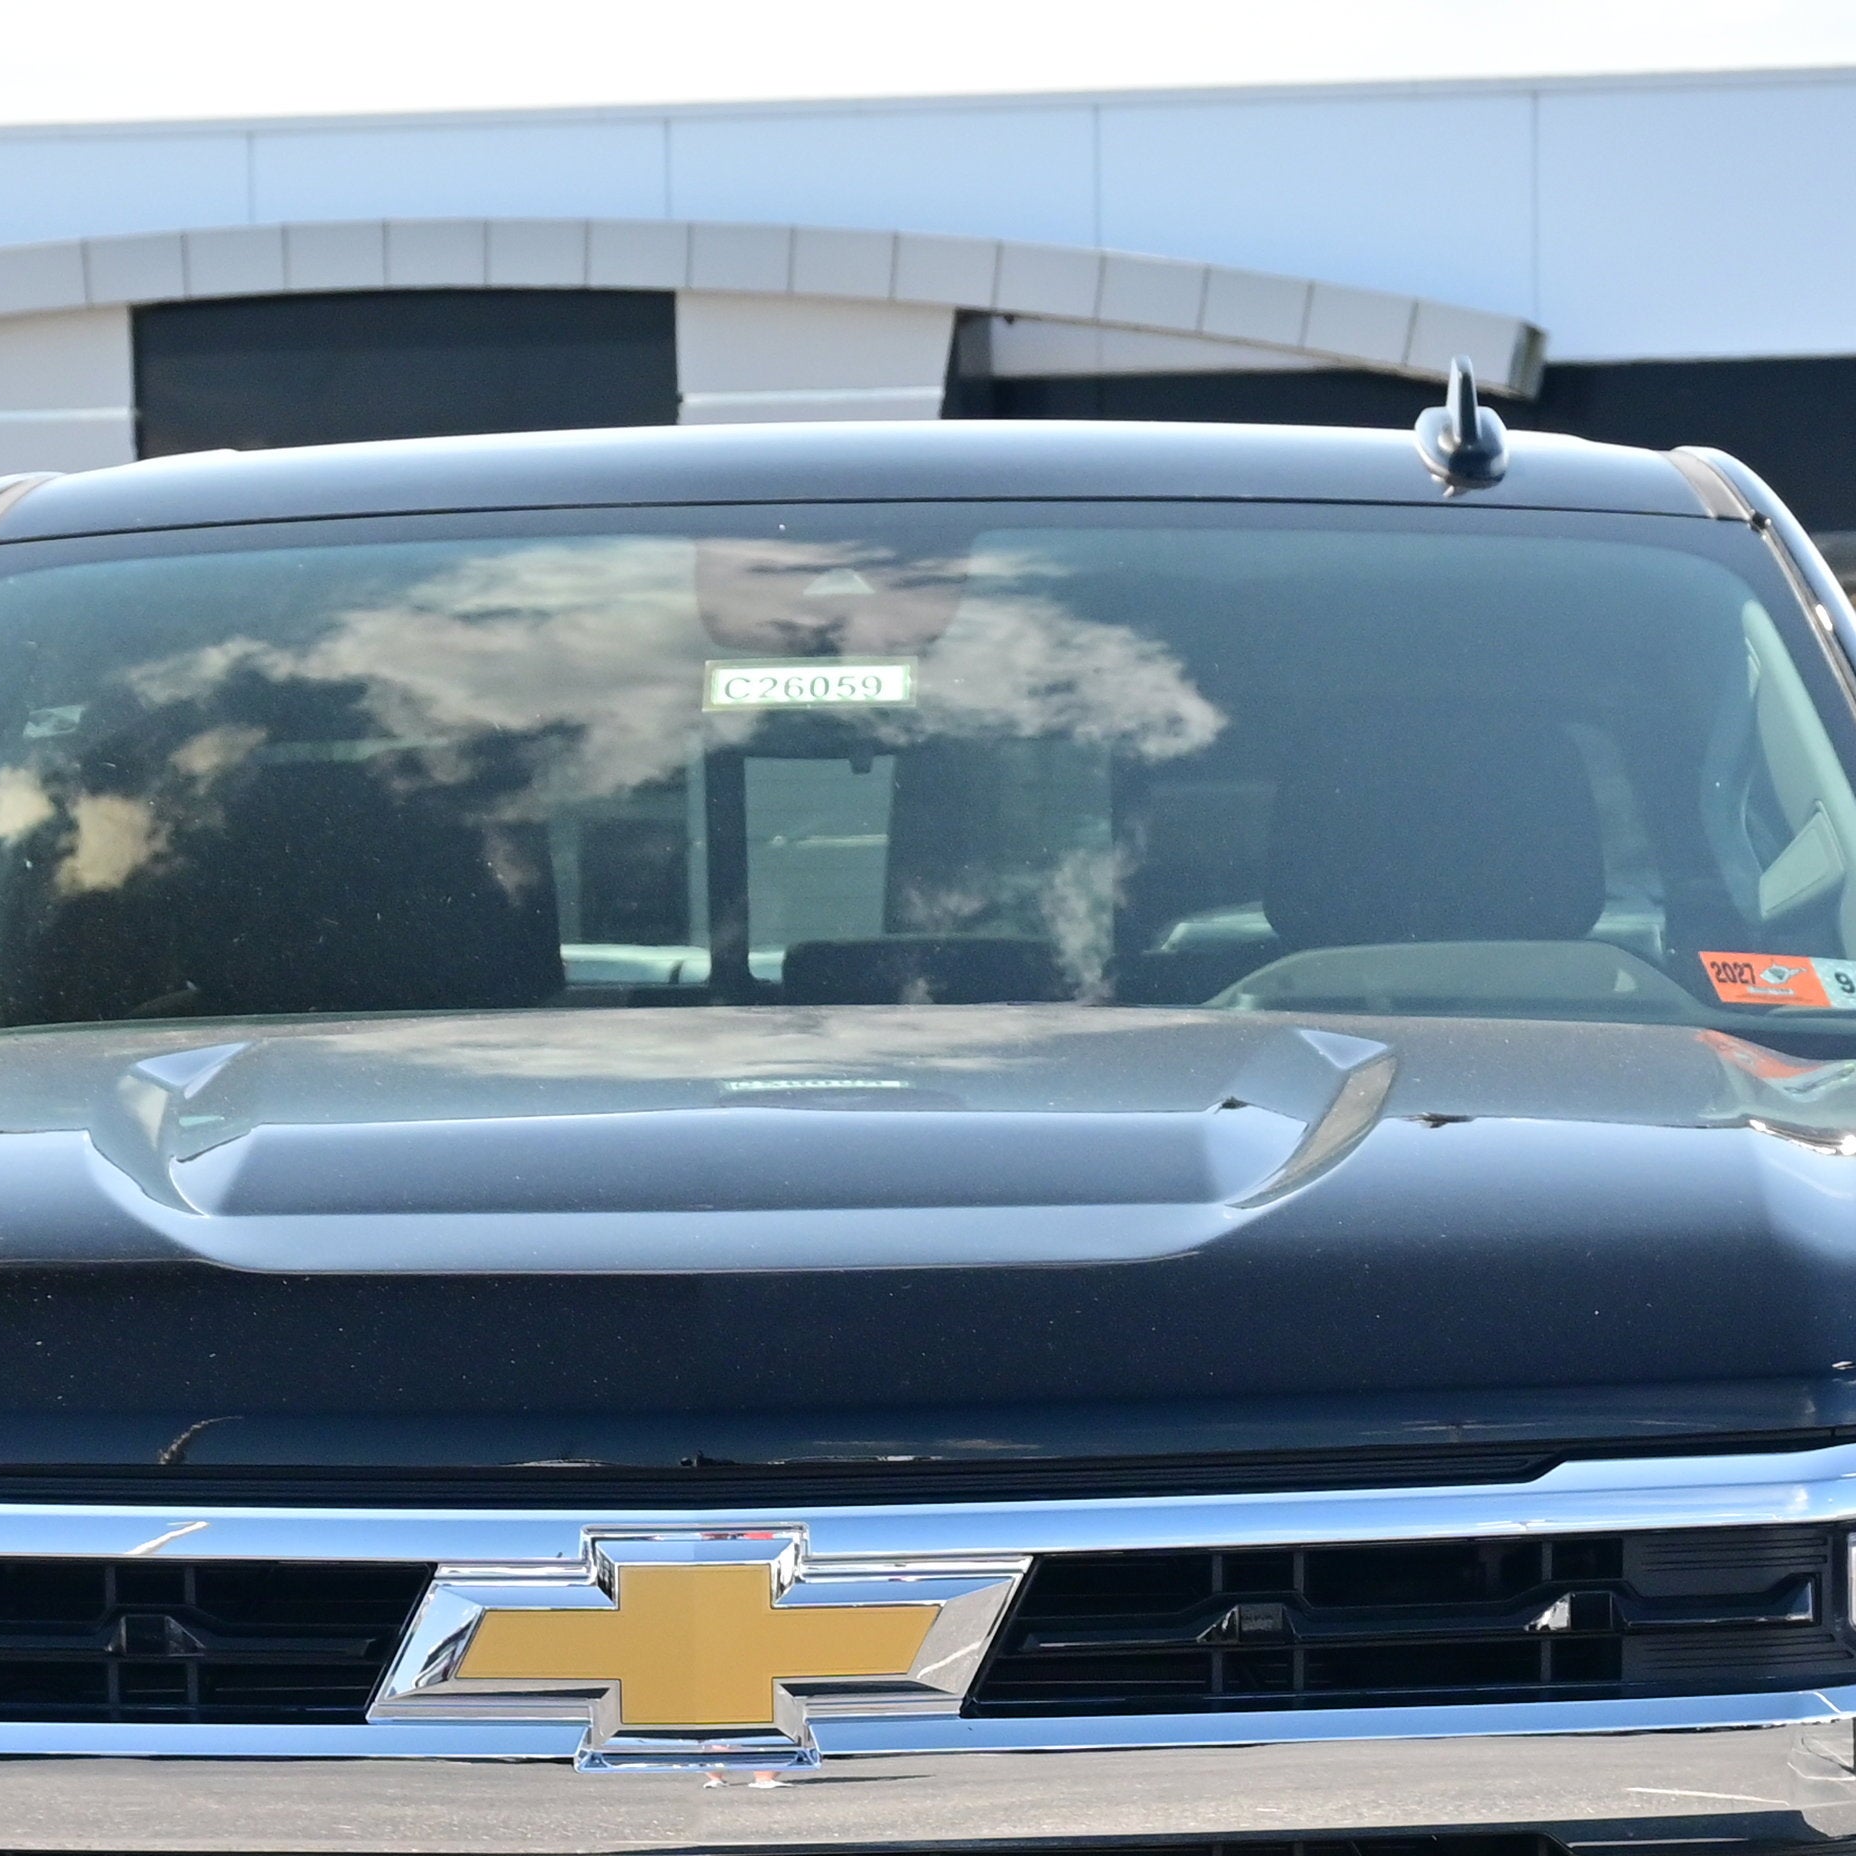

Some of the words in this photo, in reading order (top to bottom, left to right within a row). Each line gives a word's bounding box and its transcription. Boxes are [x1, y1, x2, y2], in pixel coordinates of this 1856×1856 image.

[724, 675, 883, 701] C26059
[1710, 960, 1757, 985] 2027
[1834, 971, 1856, 994] 9
